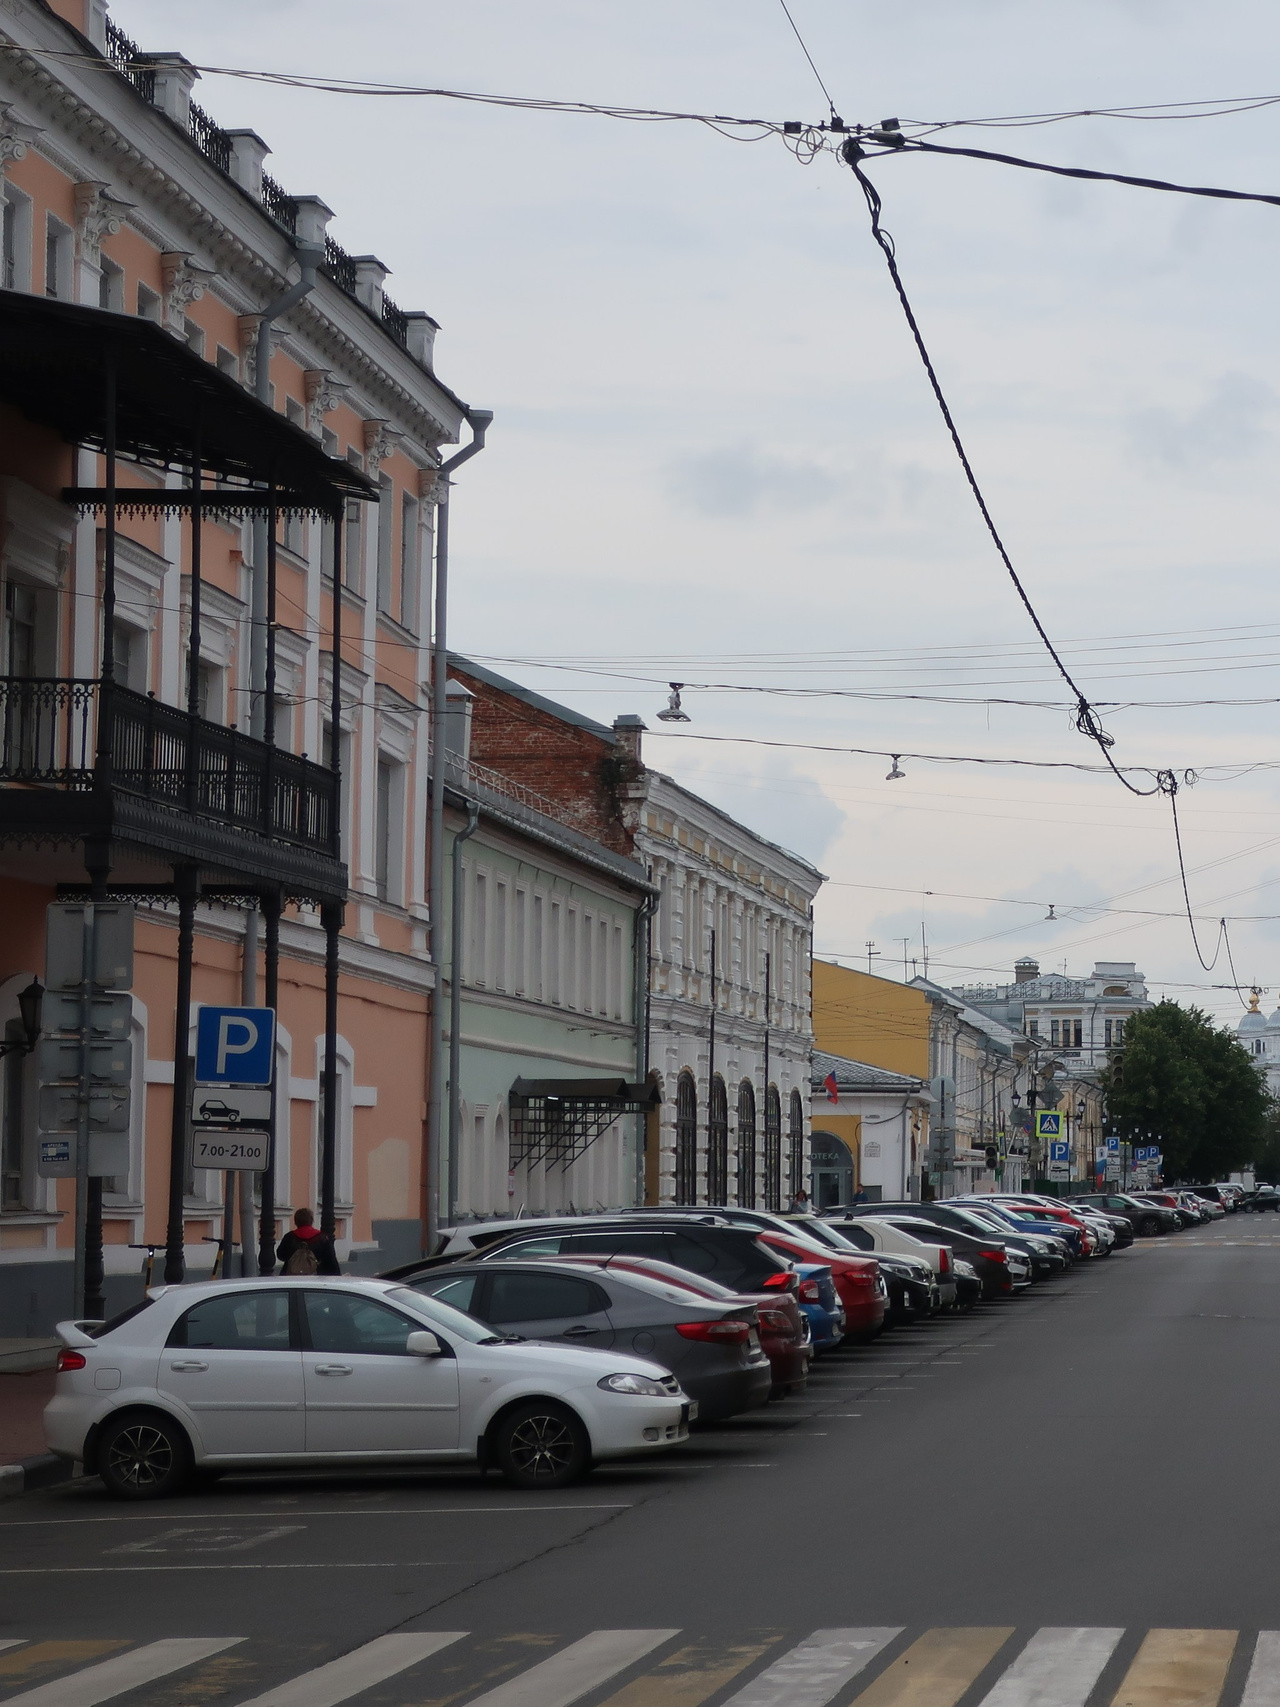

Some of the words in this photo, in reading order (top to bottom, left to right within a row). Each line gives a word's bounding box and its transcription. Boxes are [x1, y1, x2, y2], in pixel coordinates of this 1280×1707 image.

[216, 1015, 259, 1074] P
[1109, 1139, 1116, 1149] P
[200, 1143, 261, 1158] 7.00-21.00
[1055, 1144, 1066, 1160] P
[1138, 1149, 1145, 1159] P
[1150, 1147, 1157, 1157] P
[809, 1152, 840, 1160] ОТЕКА
